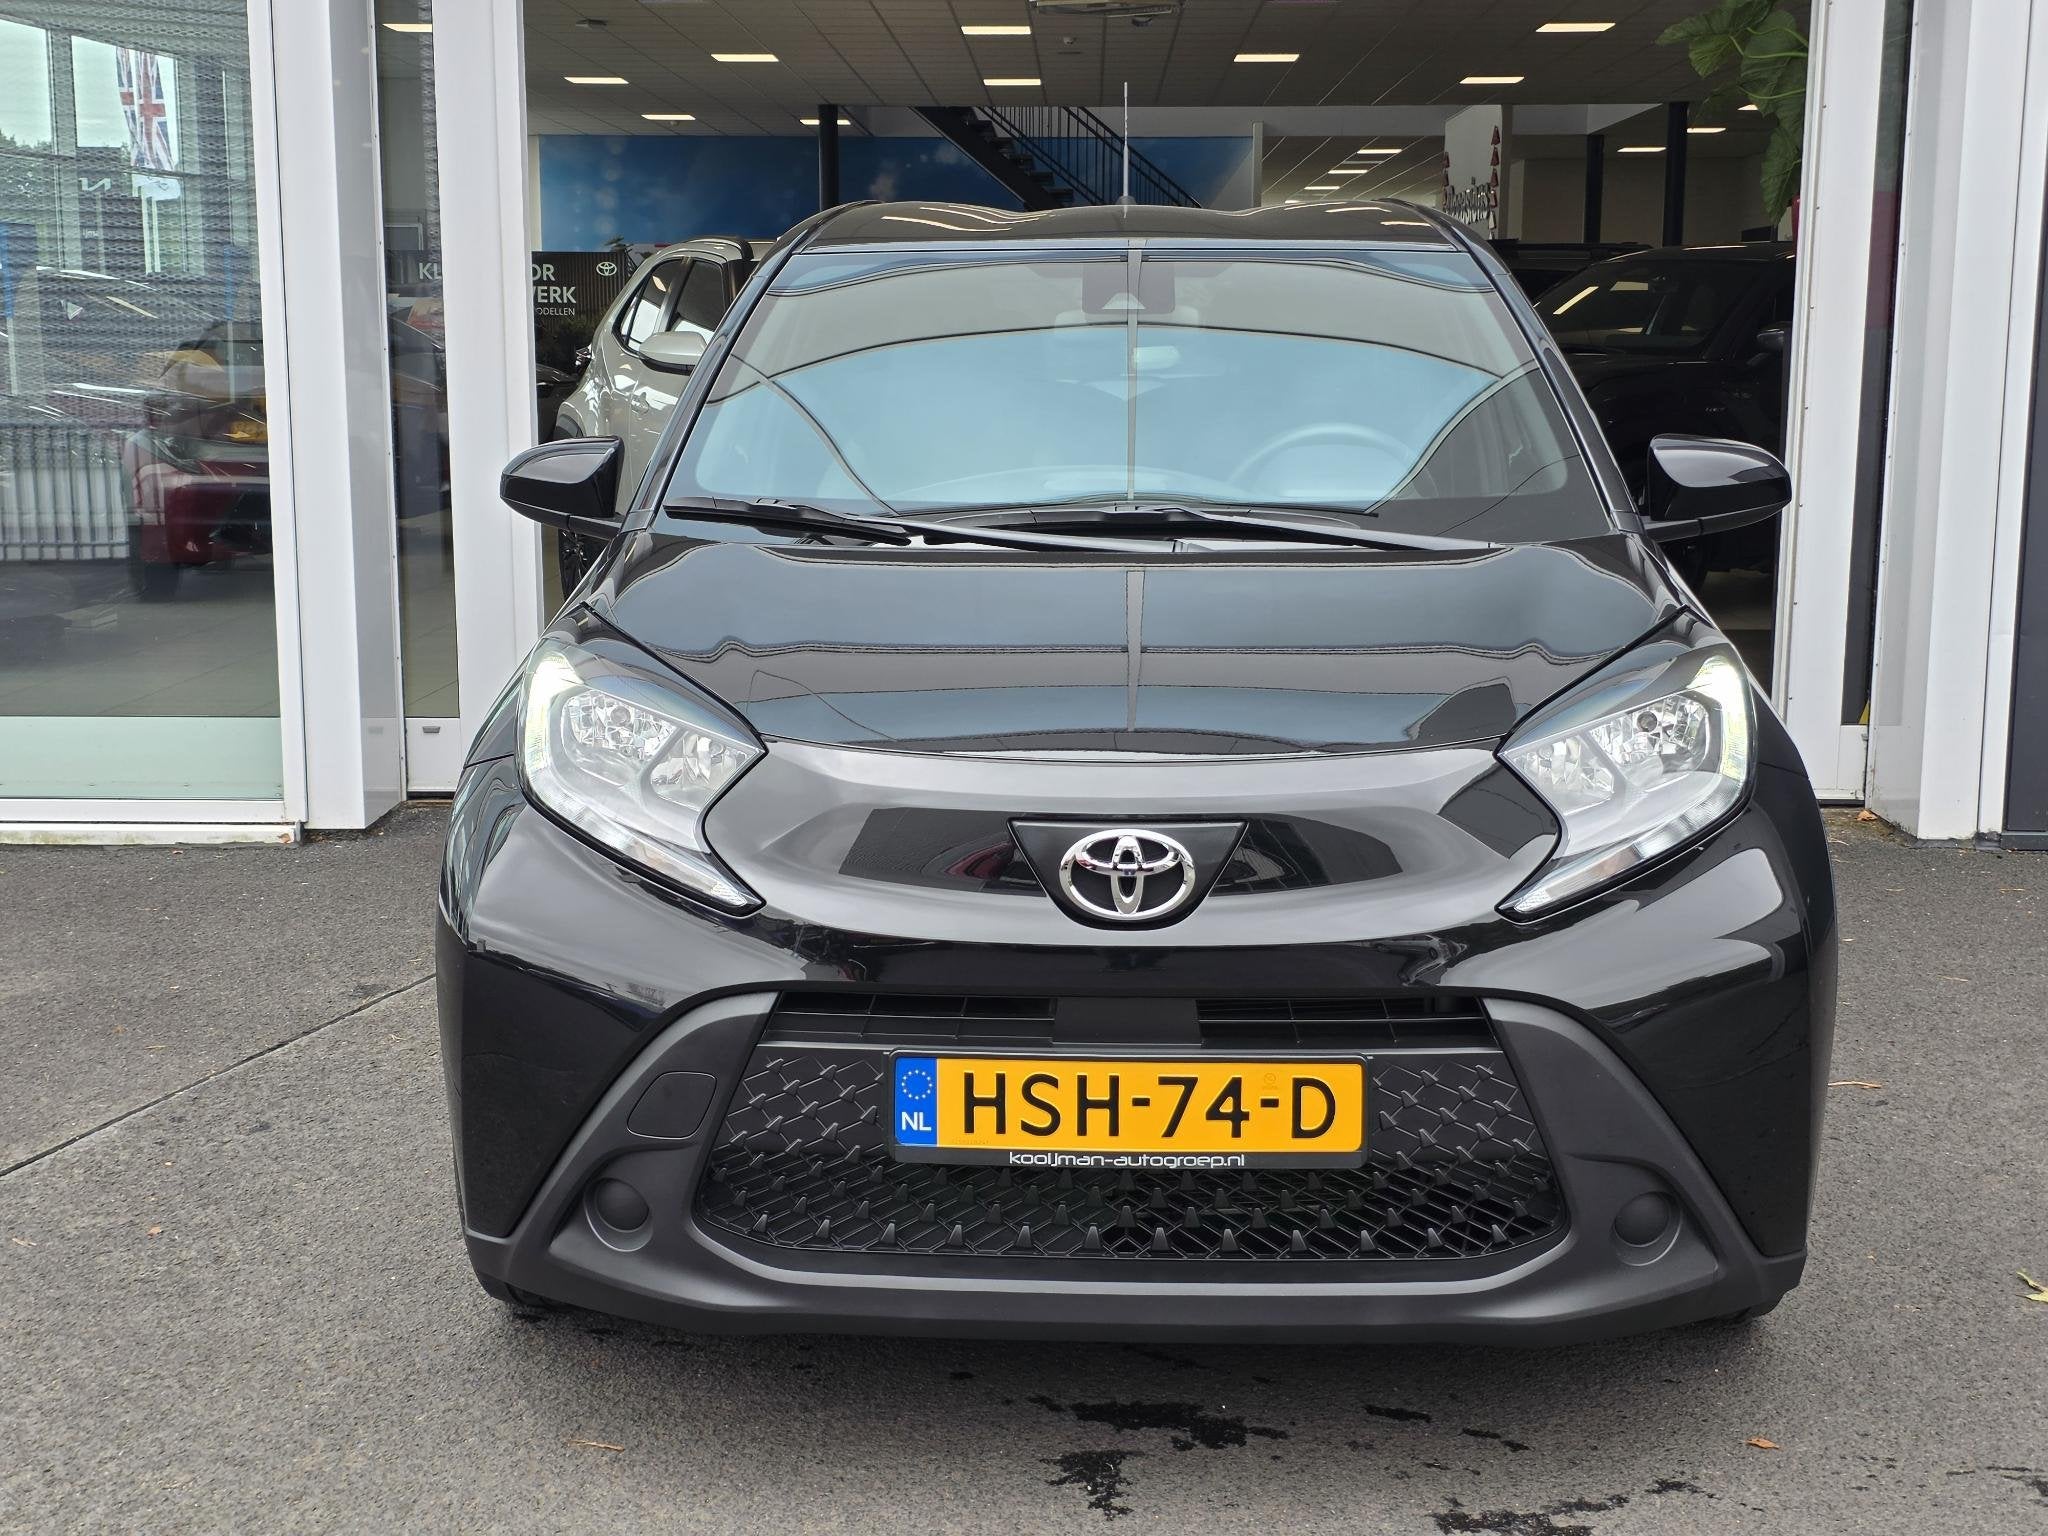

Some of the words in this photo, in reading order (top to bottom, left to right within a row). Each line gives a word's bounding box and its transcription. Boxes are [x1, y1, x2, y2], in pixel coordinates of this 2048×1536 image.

[418, 262, 443, 280] KL
[532, 263, 556, 281] OR
[533, 285, 577, 303] ERK
[535, 307, 575, 316] ODELLEN
[963, 1072, 1337, 1139] HSH-74-D
[901, 1112, 932, 1132] NL
